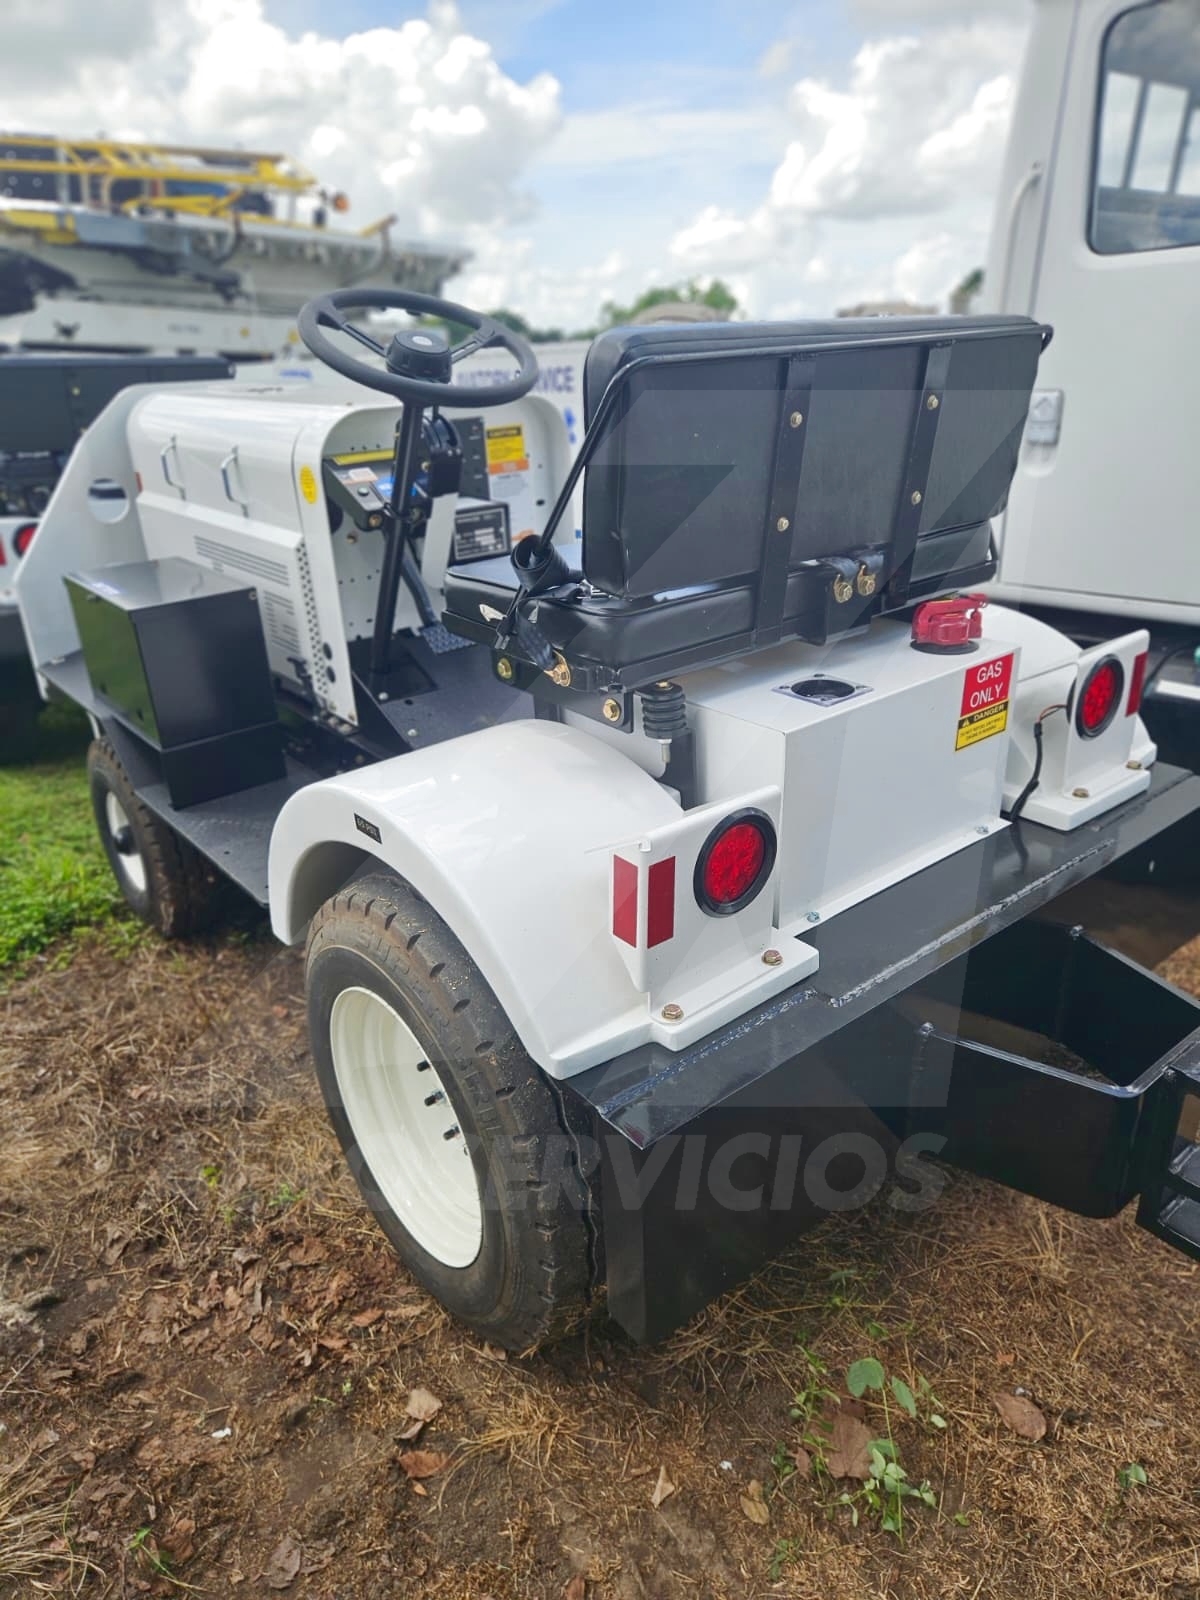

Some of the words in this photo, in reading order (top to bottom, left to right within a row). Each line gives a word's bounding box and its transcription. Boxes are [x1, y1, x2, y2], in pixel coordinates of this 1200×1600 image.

[977, 661, 1003, 684] GAS
[970, 682, 1003, 708] ONLY
[974, 703, 1004, 722] DANGER
